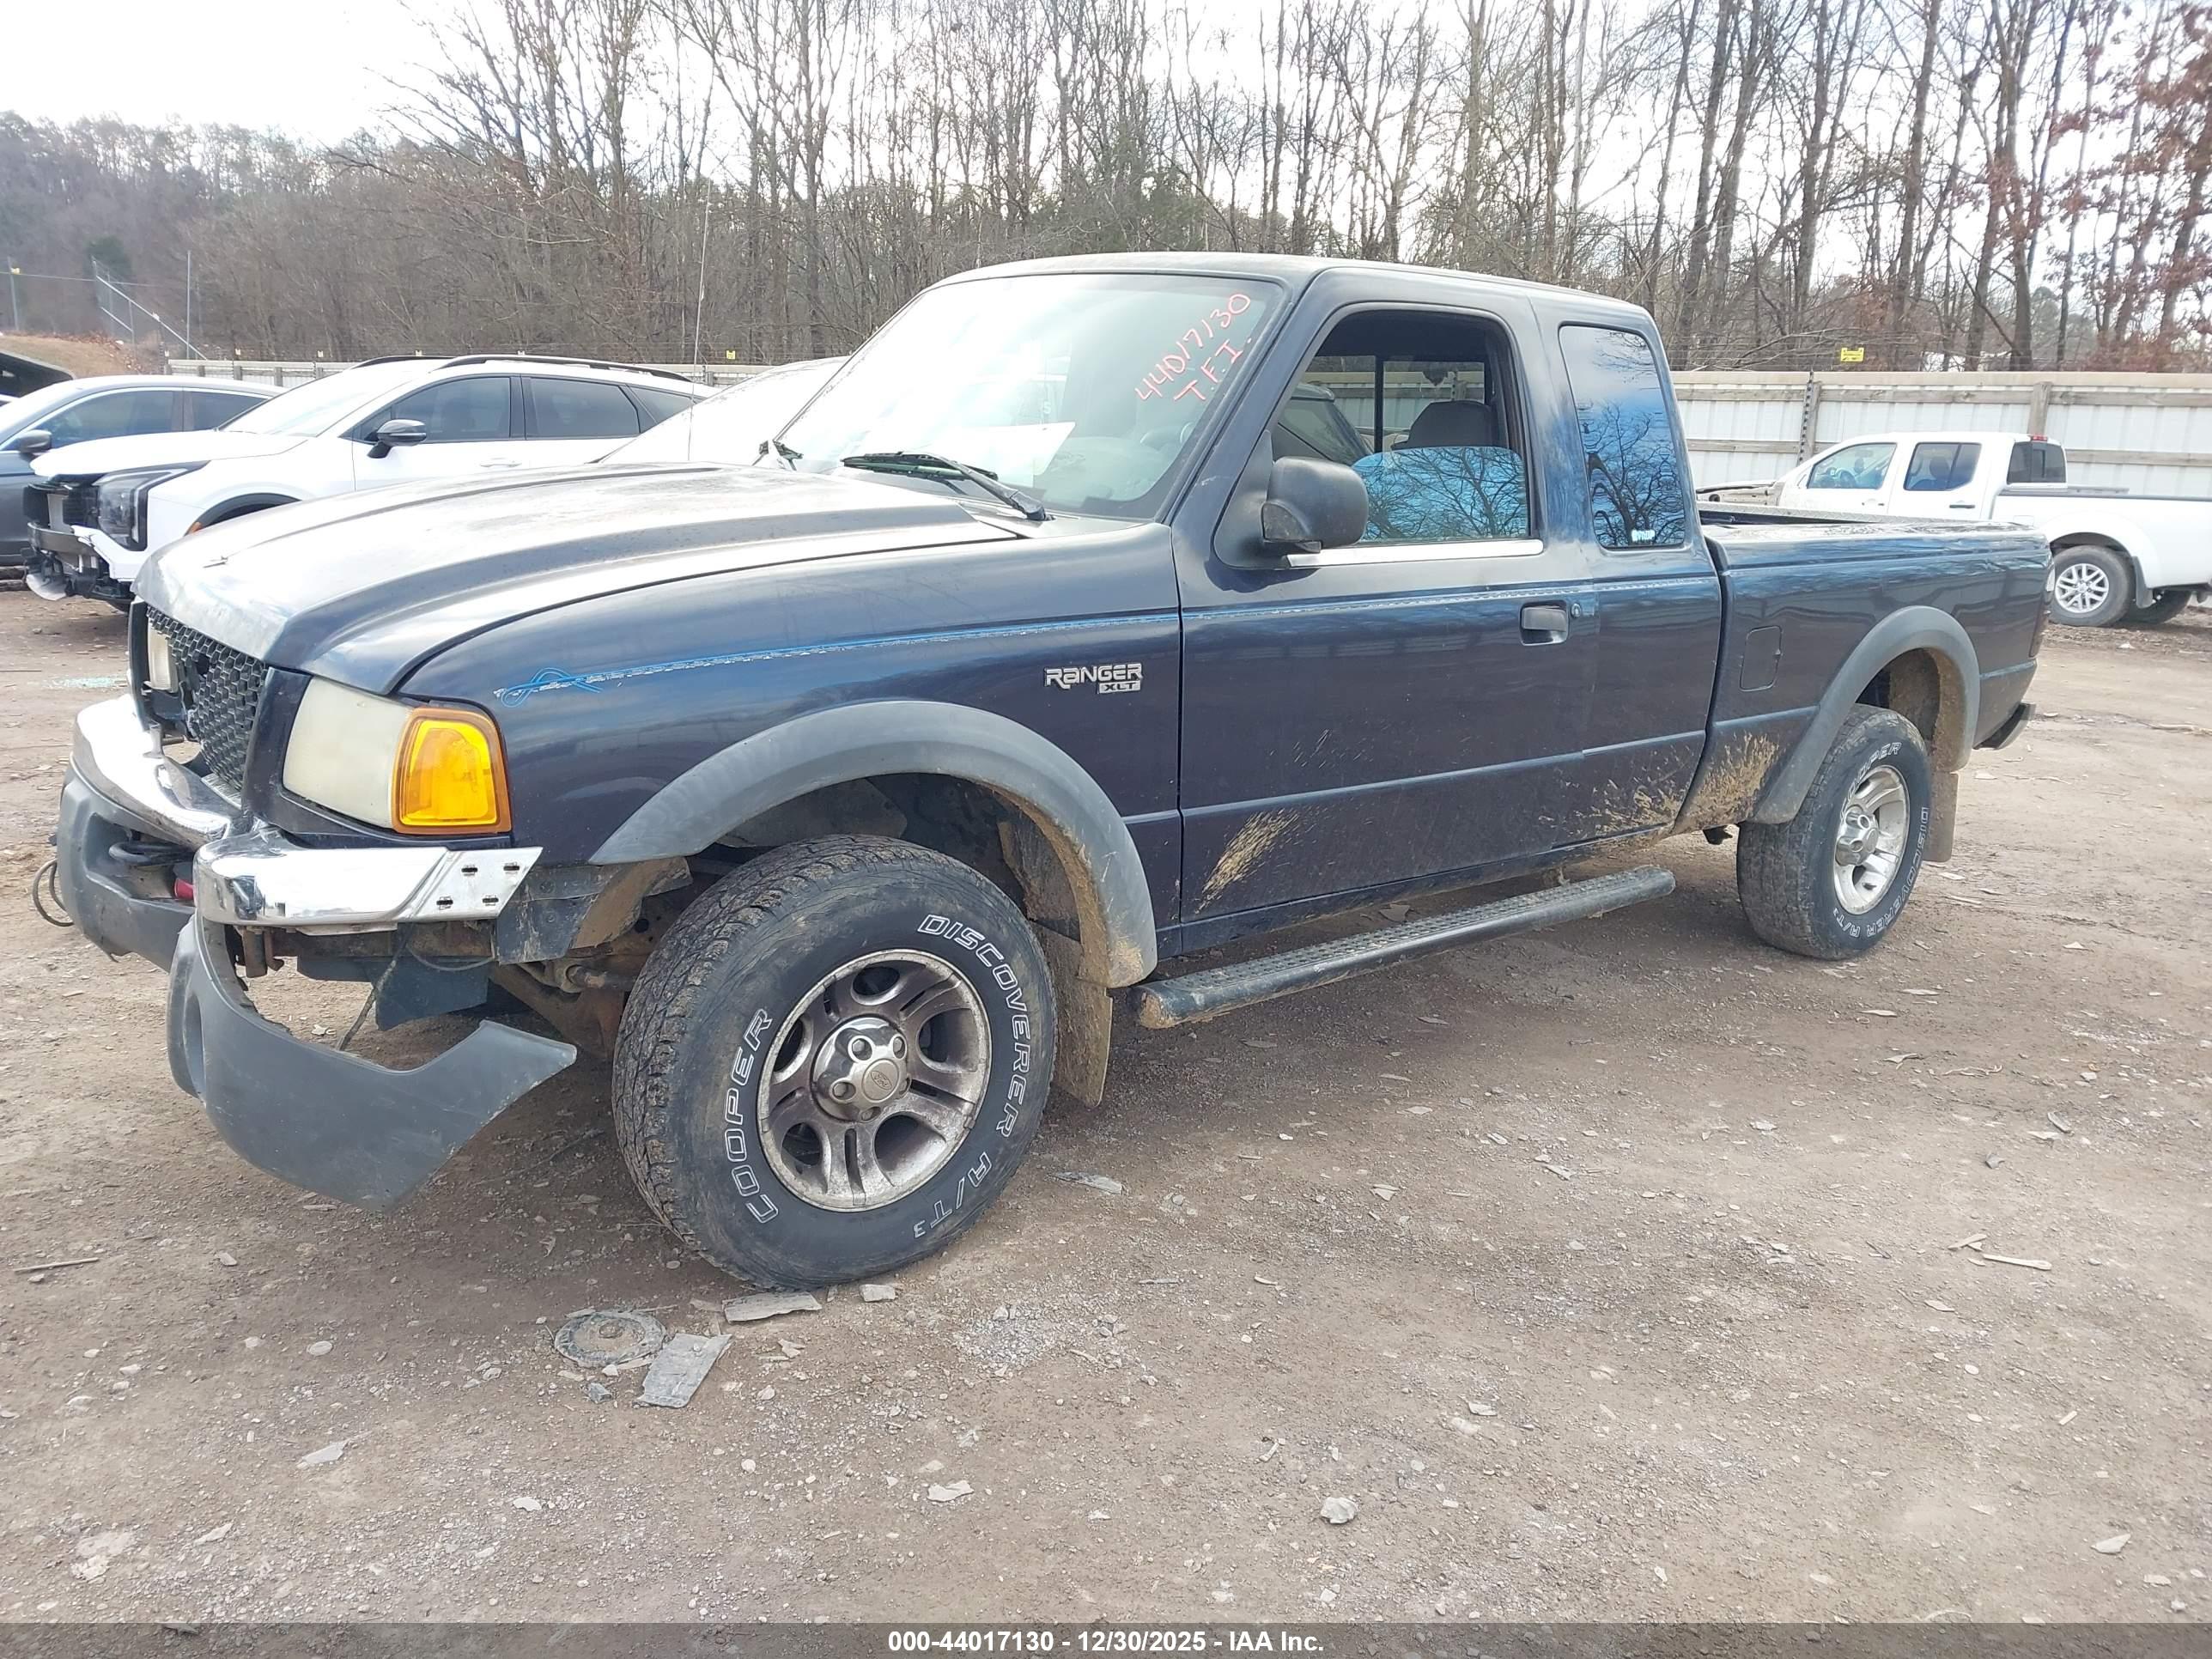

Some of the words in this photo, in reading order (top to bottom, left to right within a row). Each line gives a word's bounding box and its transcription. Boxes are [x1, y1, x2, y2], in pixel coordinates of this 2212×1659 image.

[1133, 293, 1251, 401] 44017130
[1103, 682, 1136, 692] XLT
[1840, 741, 1902, 822] COOPER
[1867, 807, 1929, 939] DISCOVERER
[916, 914, 1032, 1138] DISCOVERER
[724, 1008, 779, 1224] COOPER
